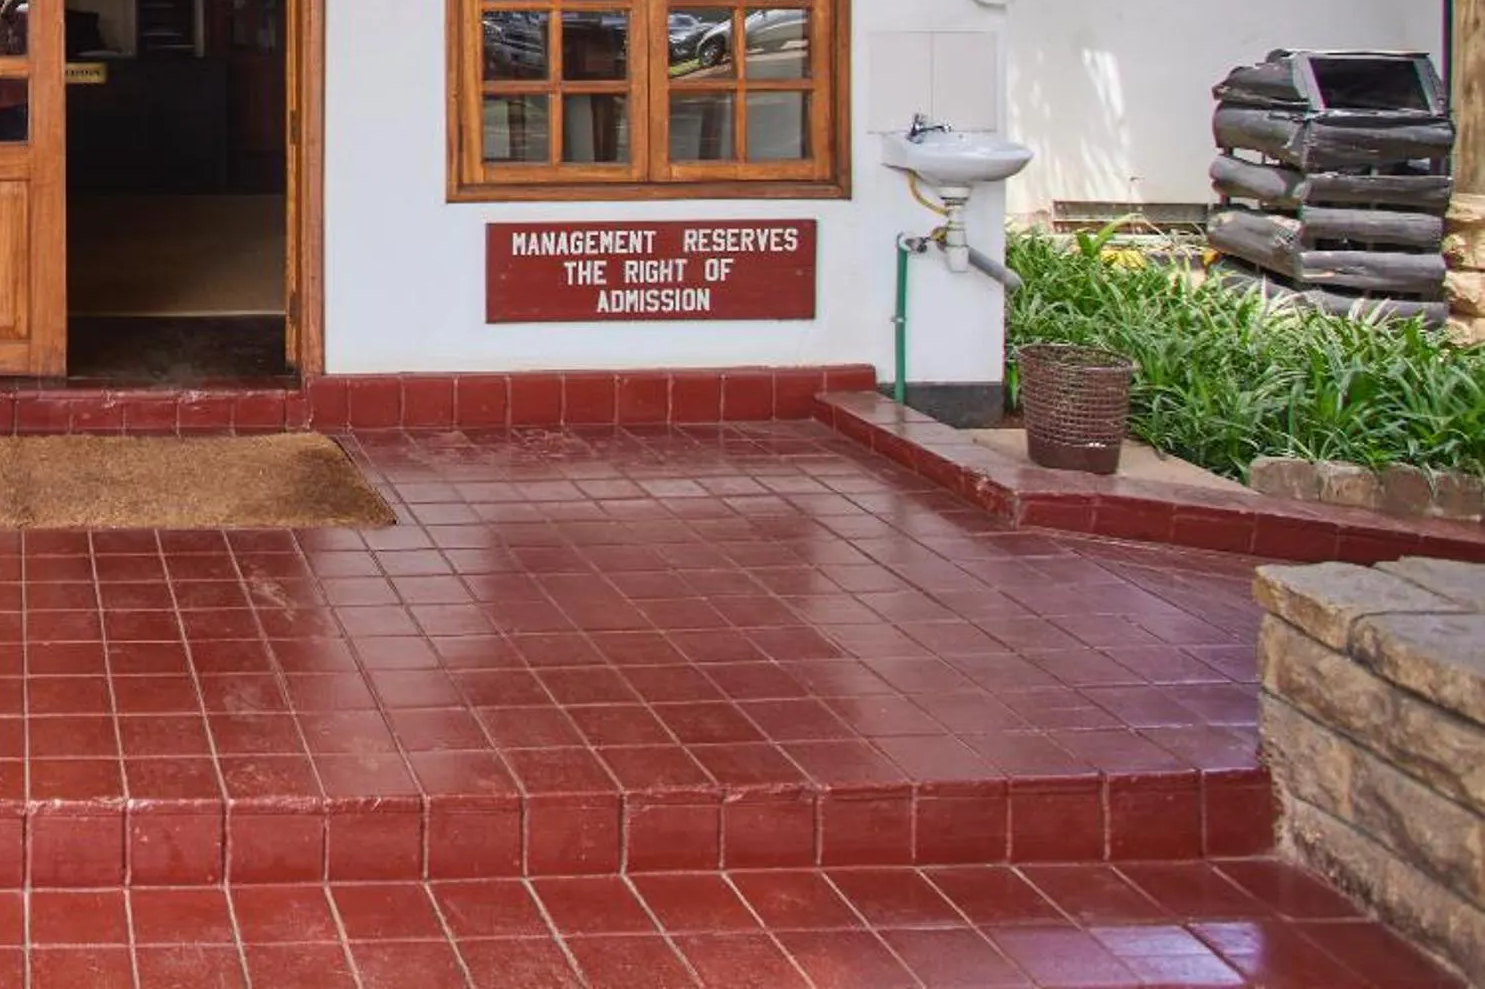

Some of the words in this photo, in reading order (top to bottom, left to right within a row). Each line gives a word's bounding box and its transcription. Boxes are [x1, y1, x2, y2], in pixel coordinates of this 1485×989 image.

[512, 230, 656, 255] MANAGEMENT
[683, 228, 798, 252] RESERVES
[564, 261, 607, 285] THE
[624, 259, 687, 283] RIGHT
[704, 258, 734, 282] OF
[596, 288, 710, 312] ADMISSION
